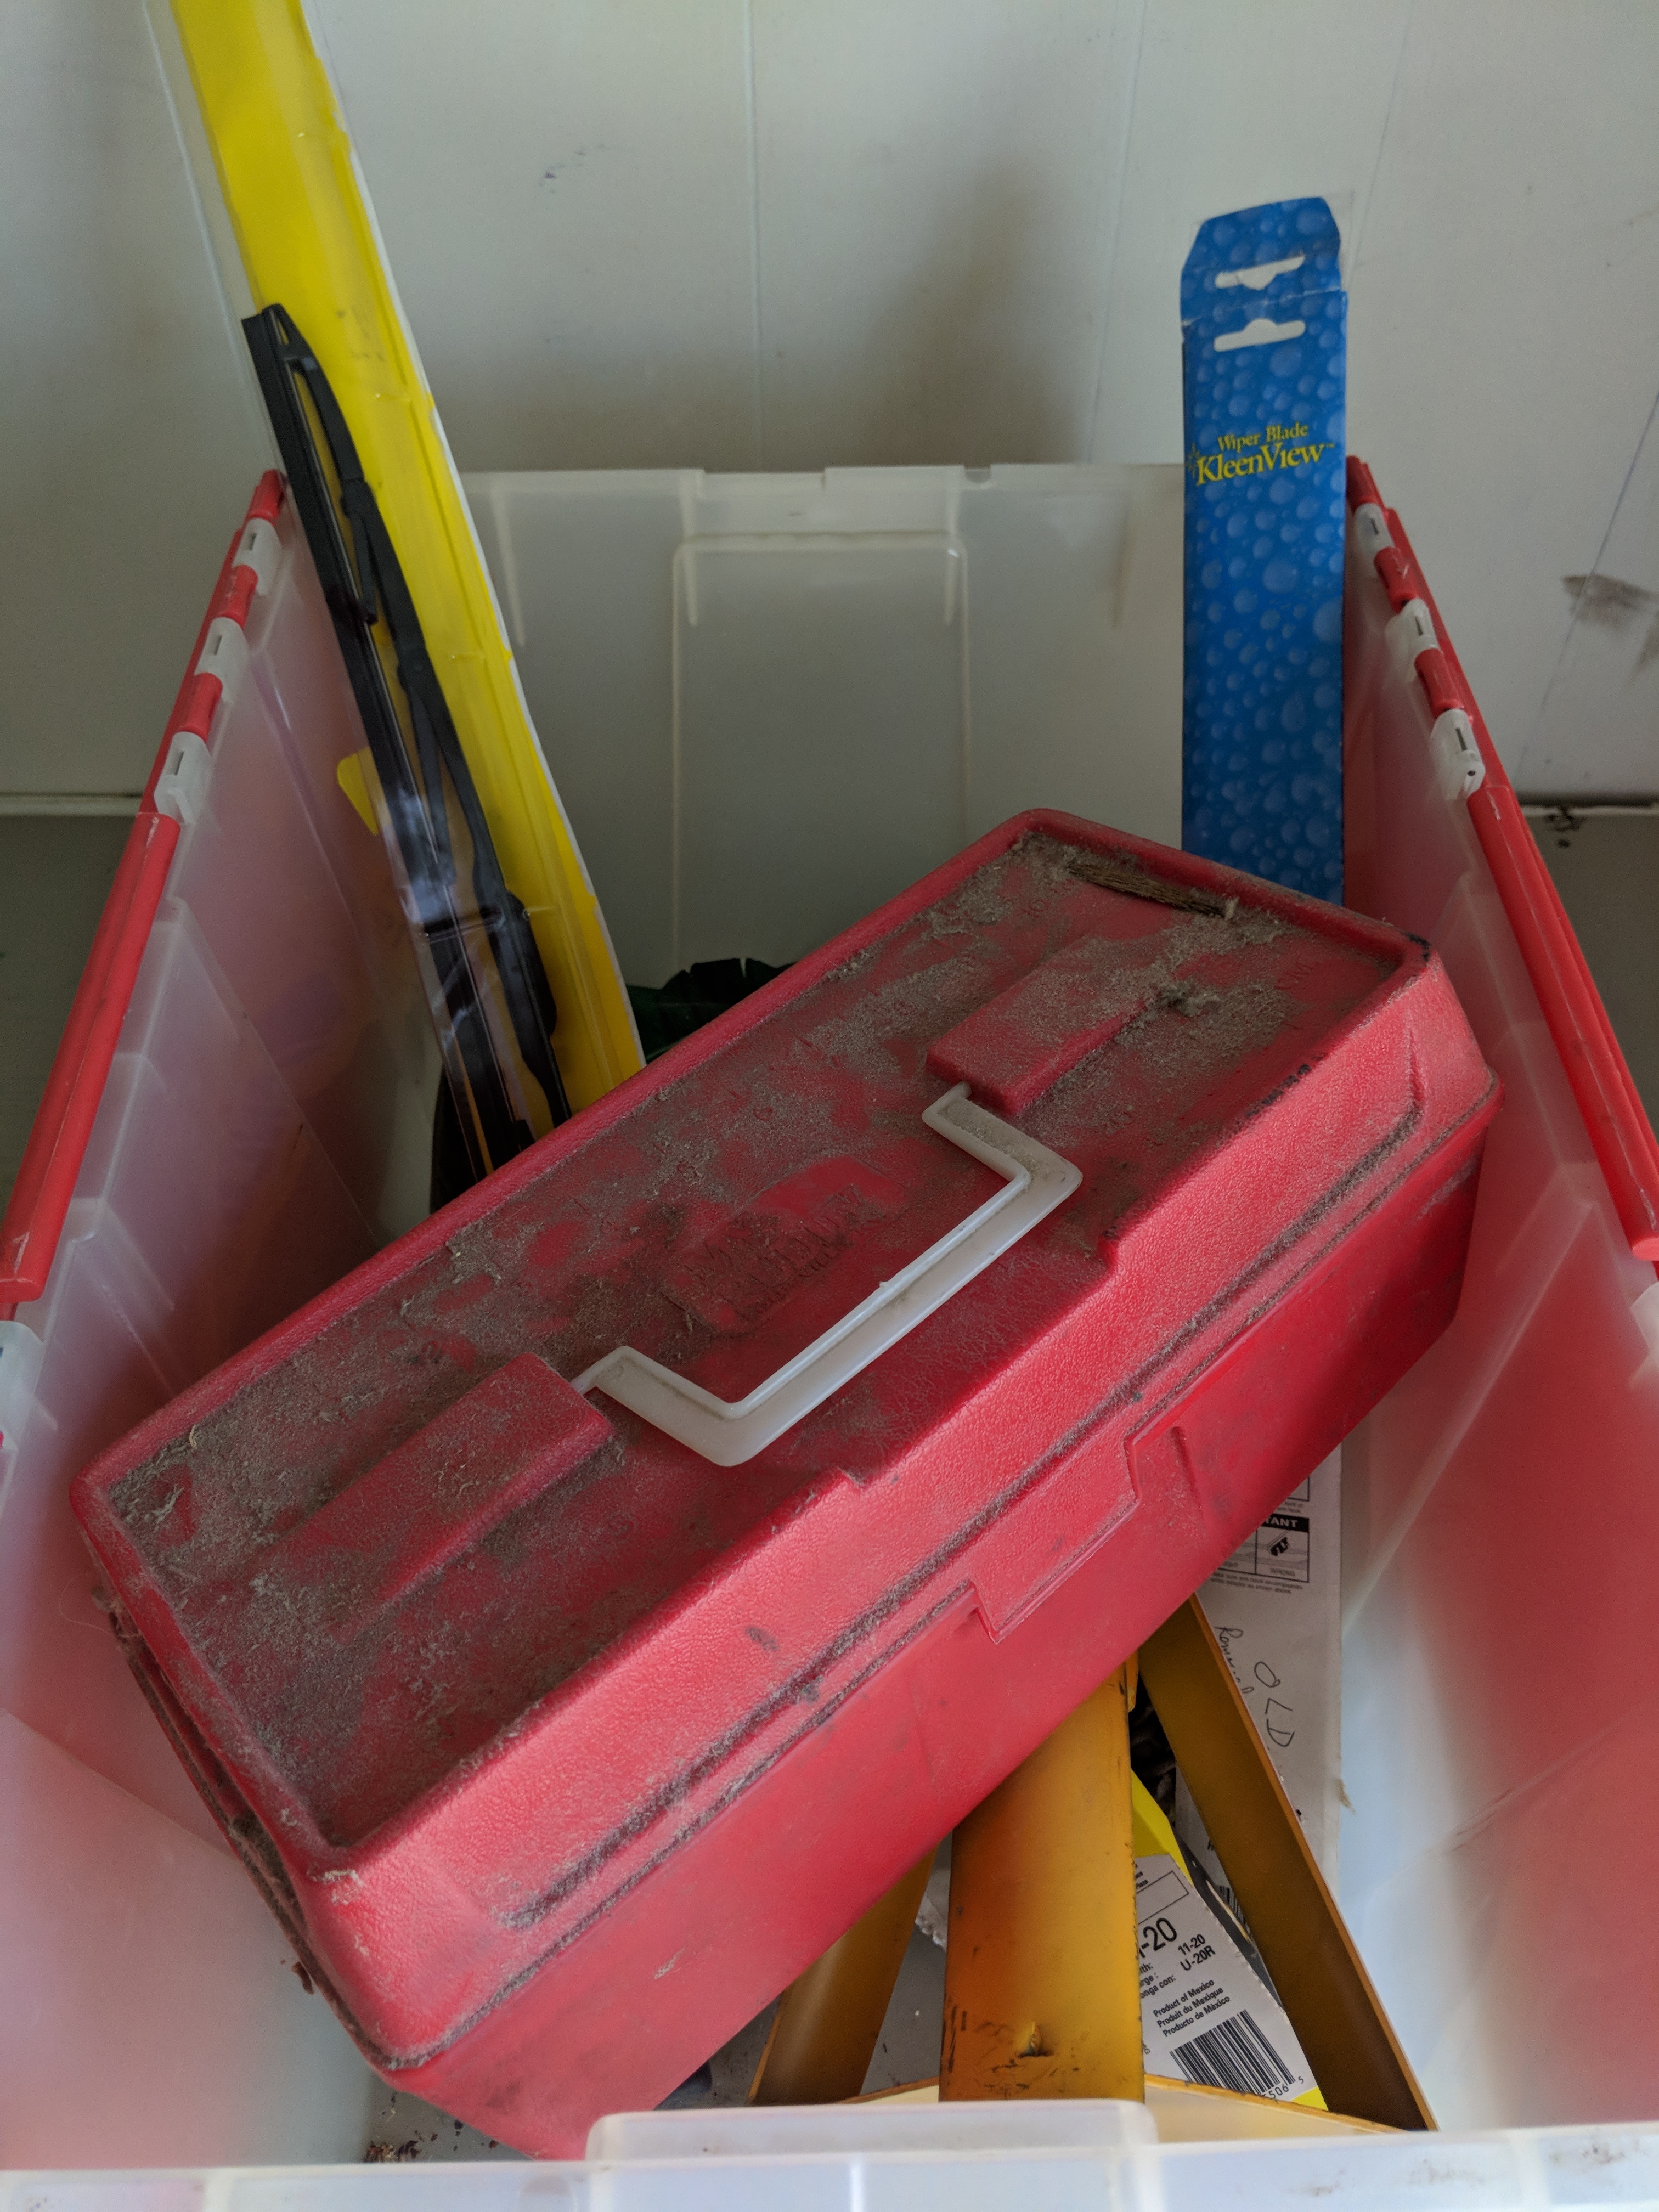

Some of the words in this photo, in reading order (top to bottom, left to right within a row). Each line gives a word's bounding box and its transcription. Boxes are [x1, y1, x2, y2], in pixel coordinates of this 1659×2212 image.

[1217, 433, 1261, 453] Wiper
[1266, 421, 1309, 442] Blade
[1195, 441, 1325, 486] KleenView
[1269, 1567, 1296, 1577] WRONG
[1254, 1660, 1295, 1747] OLD
[1177, 1933, 1206, 1956] 11-20
[1180, 1945, 1216, 1971] U-20R
[1158, 1974, 1176, 1989] con:
[1153, 1998, 1181, 2017] Product
[1181, 1993, 1189, 2002] of
[1187, 1979, 1215, 1998] Mexico
[1156, 2010, 1183, 2028] Produit
[1183, 2005, 1193, 2014] du
[1192, 1987, 1224, 2008] Mexique
[1162, 2017, 1195, 2038] Producto
[1194, 2011, 1204, 2020] de
[1297, 2075, 1304, 2084] 5
